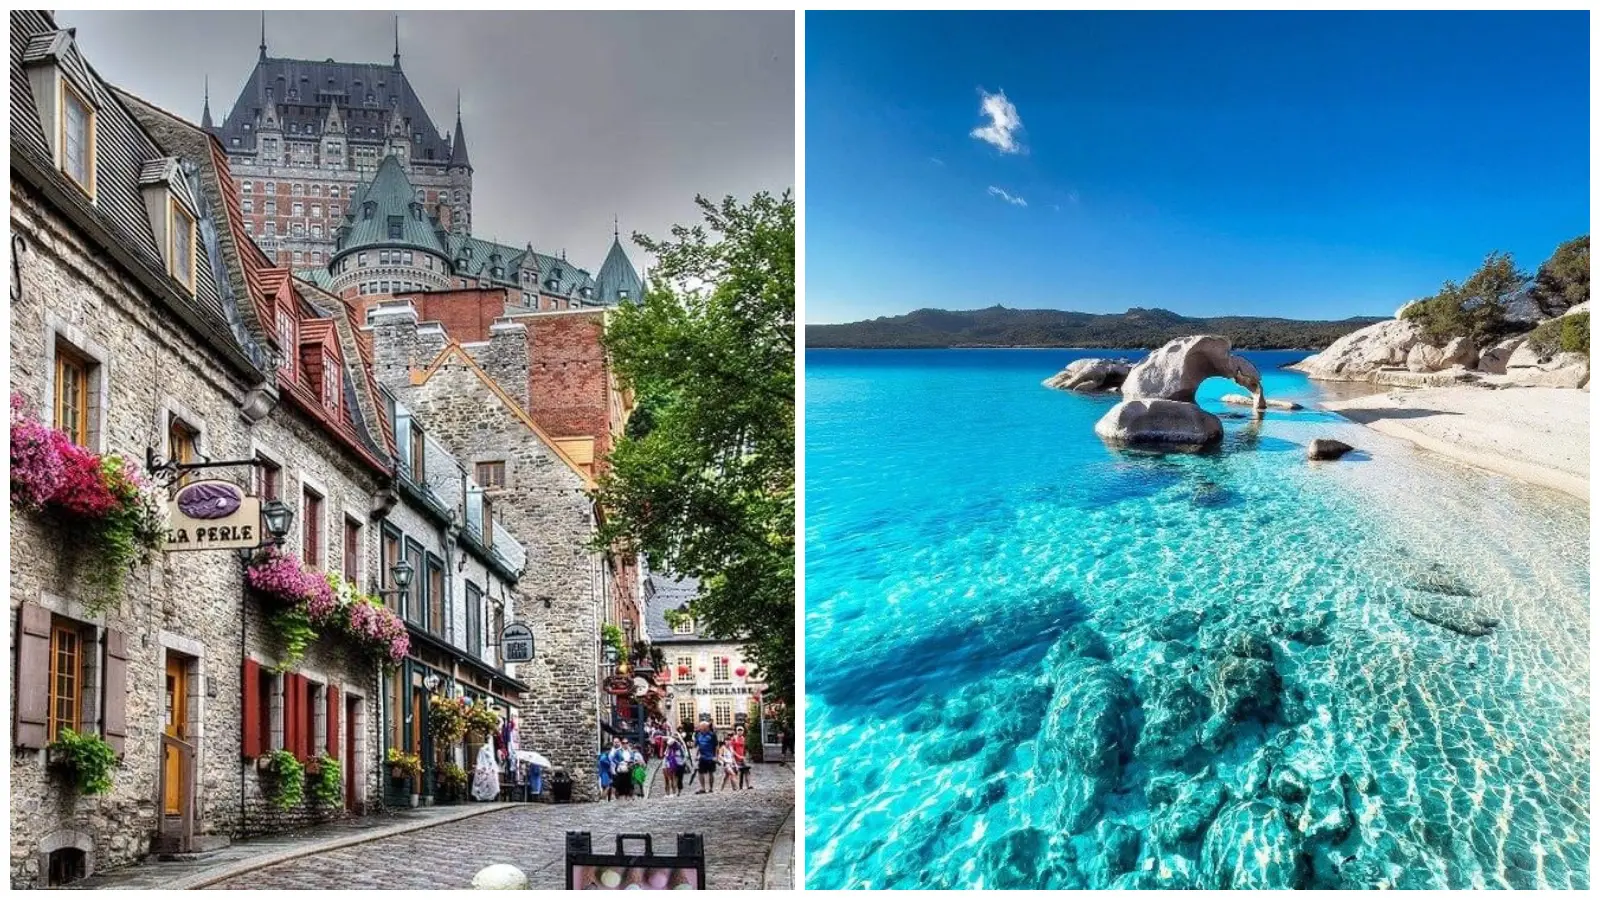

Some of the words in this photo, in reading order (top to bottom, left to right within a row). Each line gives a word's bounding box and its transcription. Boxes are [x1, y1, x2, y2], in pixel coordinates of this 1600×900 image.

[167, 528, 190, 543] LA
[196, 525, 253, 542] PERLE
[690, 687, 754, 696] FUNICULAIRE
